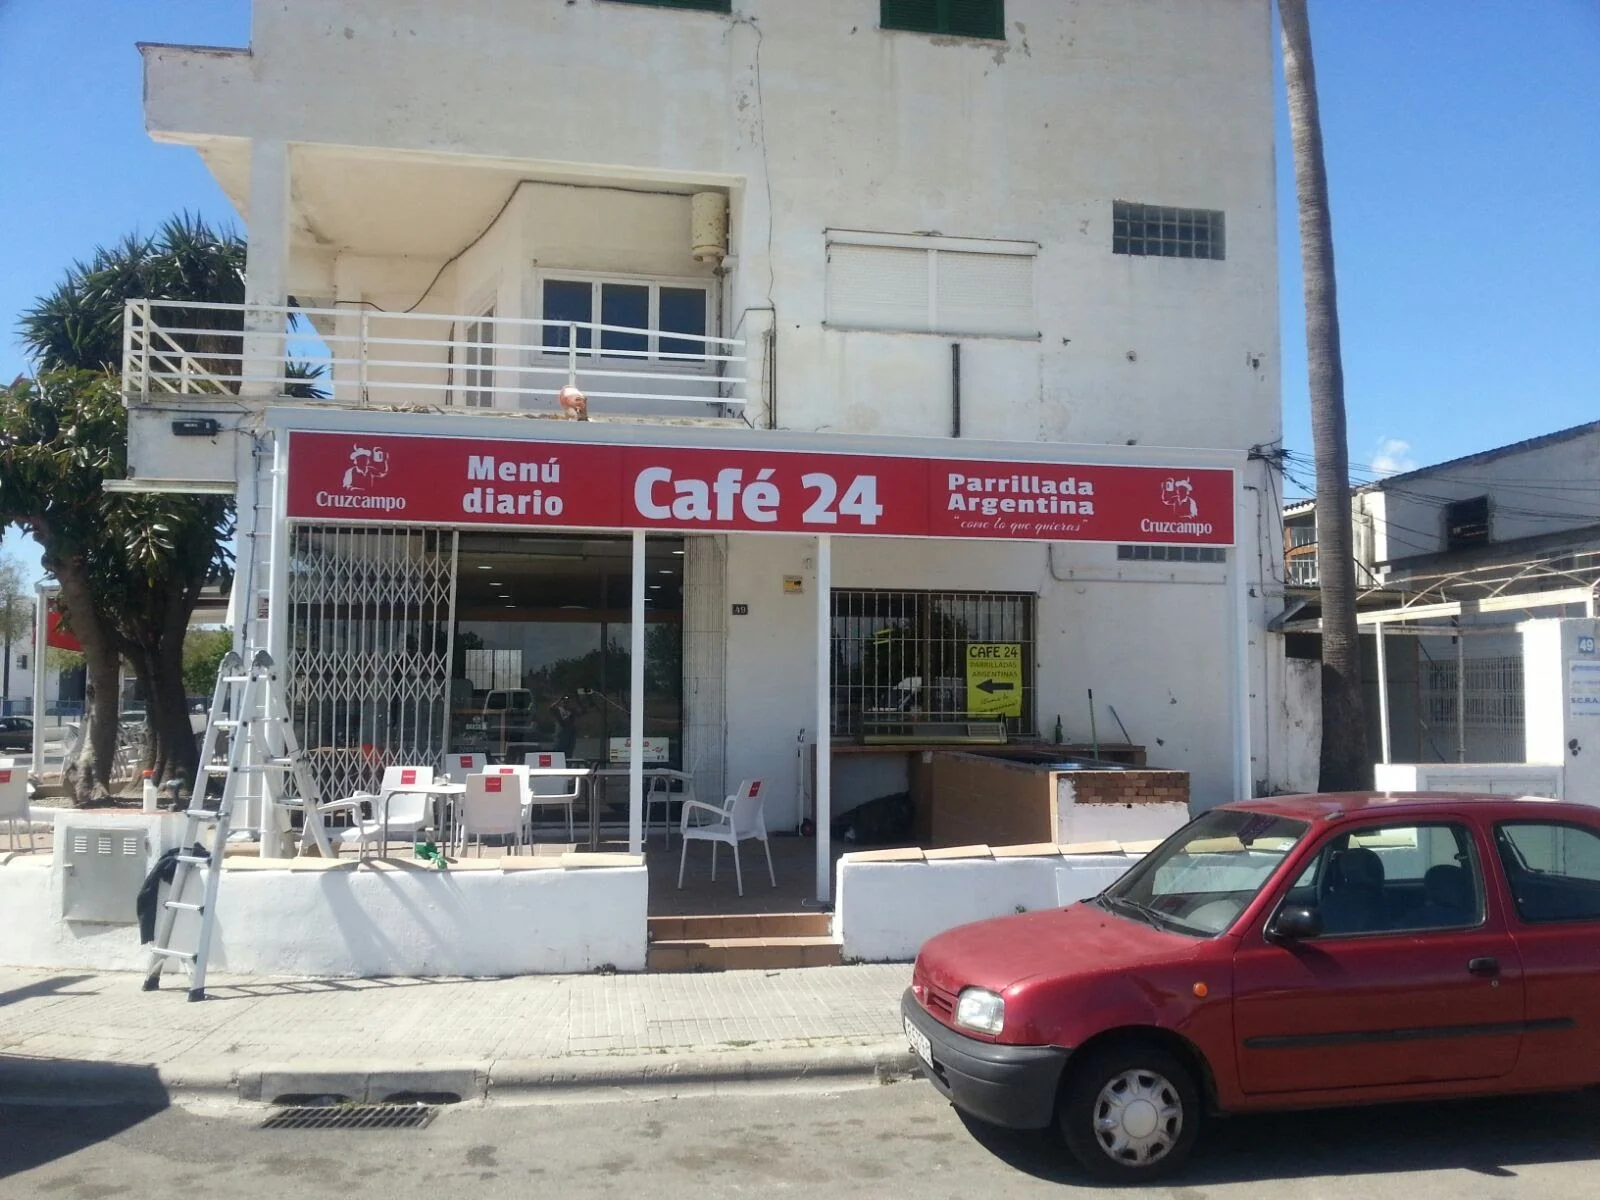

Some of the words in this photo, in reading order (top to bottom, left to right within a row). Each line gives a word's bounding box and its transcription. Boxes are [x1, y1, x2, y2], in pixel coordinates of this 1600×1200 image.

[467, 455, 560, 484] Menú
[634, 466, 780, 523] Café
[801, 472, 884, 525] 24
[947, 473, 1094, 496] Parrillada
[316, 491, 406, 511] Cruzcampo
[462, 487, 563, 516] diario
[947, 493, 1095, 516] Argentina
[1140, 517, 1213, 537] Cruzcampo
[969, 646, 1000, 658] CAFE
[1004, 646, 1018, 658] 24
[1579, 639, 1594, 652] 49
